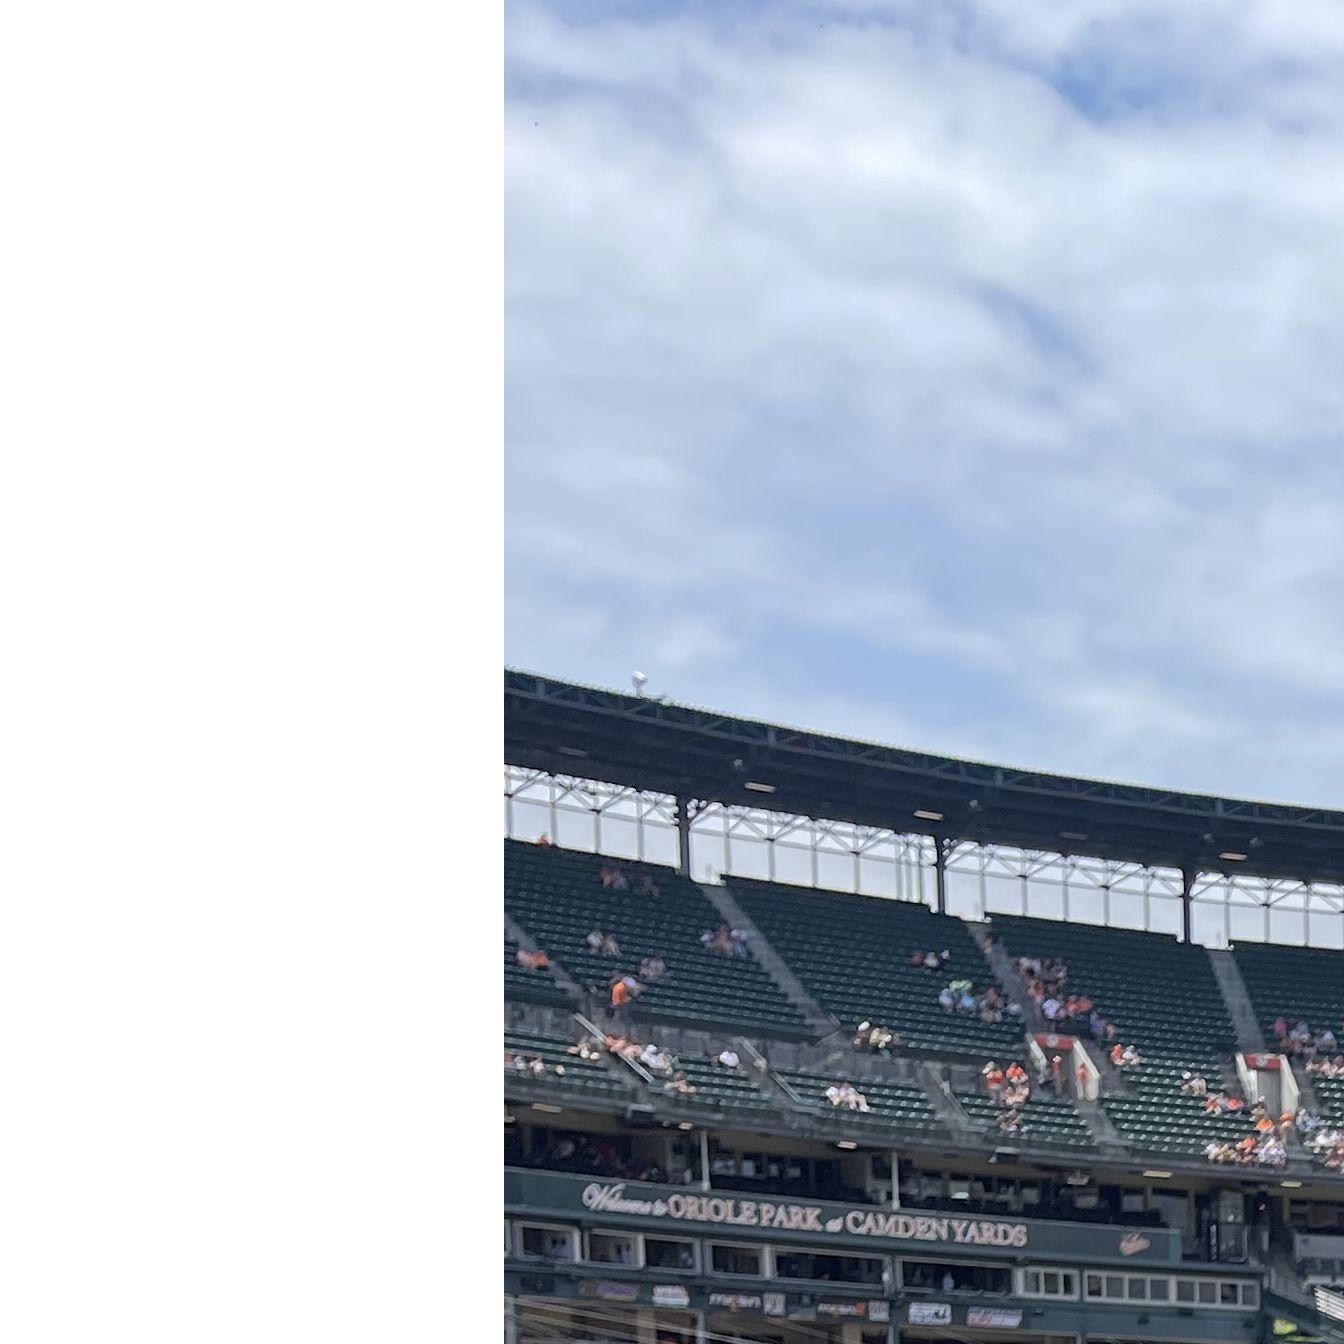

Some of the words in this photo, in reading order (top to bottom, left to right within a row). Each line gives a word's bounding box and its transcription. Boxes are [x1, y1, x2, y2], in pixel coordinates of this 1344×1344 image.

[667, 1194, 757, 1226] ORIOLE
[758, 1202, 824, 1232] PARK
[845, 1210, 950, 1242] CAMDEN
[951, 1219, 1029, 1248] YARDS
